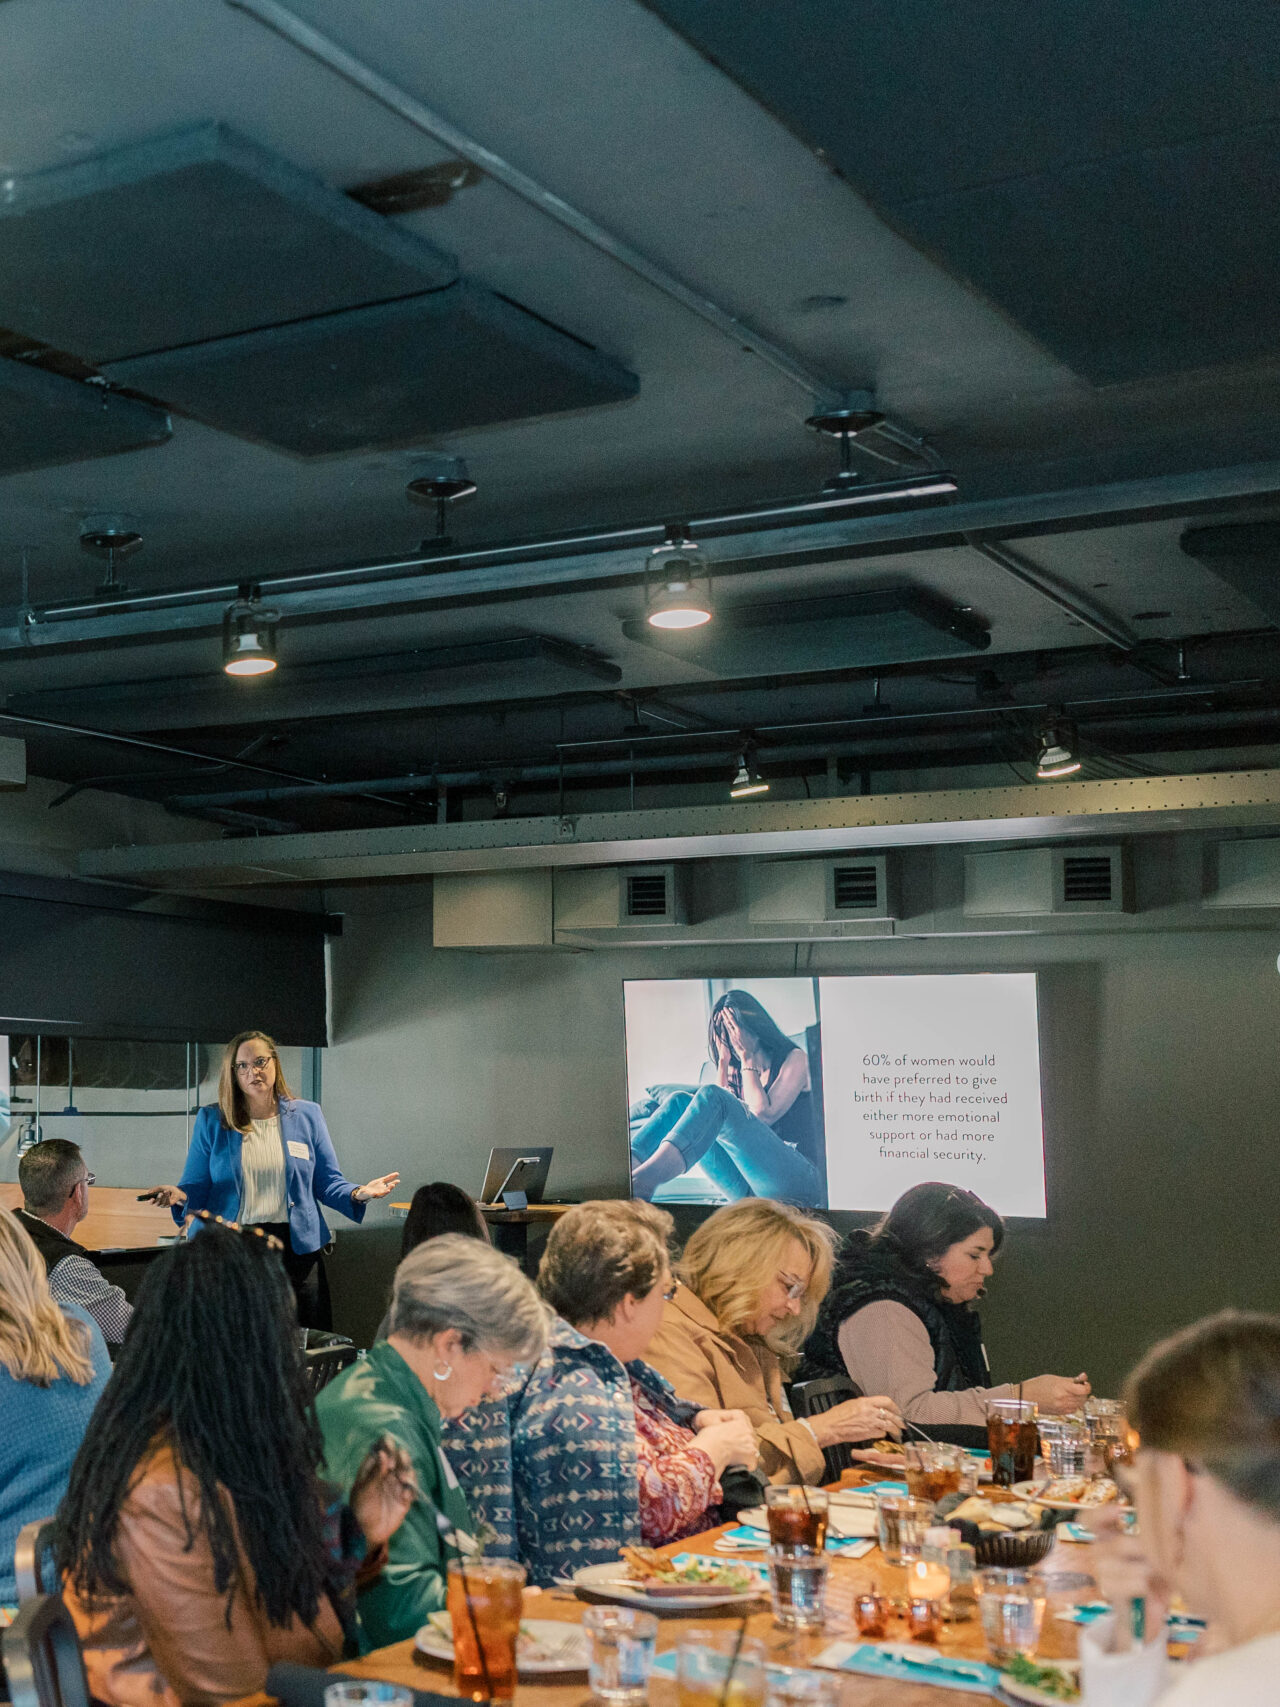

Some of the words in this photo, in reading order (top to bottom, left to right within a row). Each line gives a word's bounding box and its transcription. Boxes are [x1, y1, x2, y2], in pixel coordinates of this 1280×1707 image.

[862, 1053, 891, 1066] 60%
[894, 1053, 908, 1067] of
[910, 1058, 955, 1067] women
[958, 1053, 996, 1067] would
[862, 1072, 891, 1085] have
[893, 1072, 952, 1089] preferred
[955, 1075, 969, 1085] to
[972, 1073, 998, 1090] give
[853, 1090, 883, 1103] birth
[886, 1090, 895, 1103] if
[898, 1091, 926, 1108] they
[929, 1091, 952, 1104] had
[955, 1091, 1008, 1105] received
[862, 1108, 899, 1121] either
[902, 1113, 934, 1122] more
[937, 1110, 1000, 1123] emotional
[869, 1131, 916, 1144] support
[919, 1132, 933, 1141] or
[935, 1128, 958, 1141] had
[962, 1133, 995, 1142] more
[879, 1145, 929, 1159] financial
[933, 1148, 986, 1165] security.
